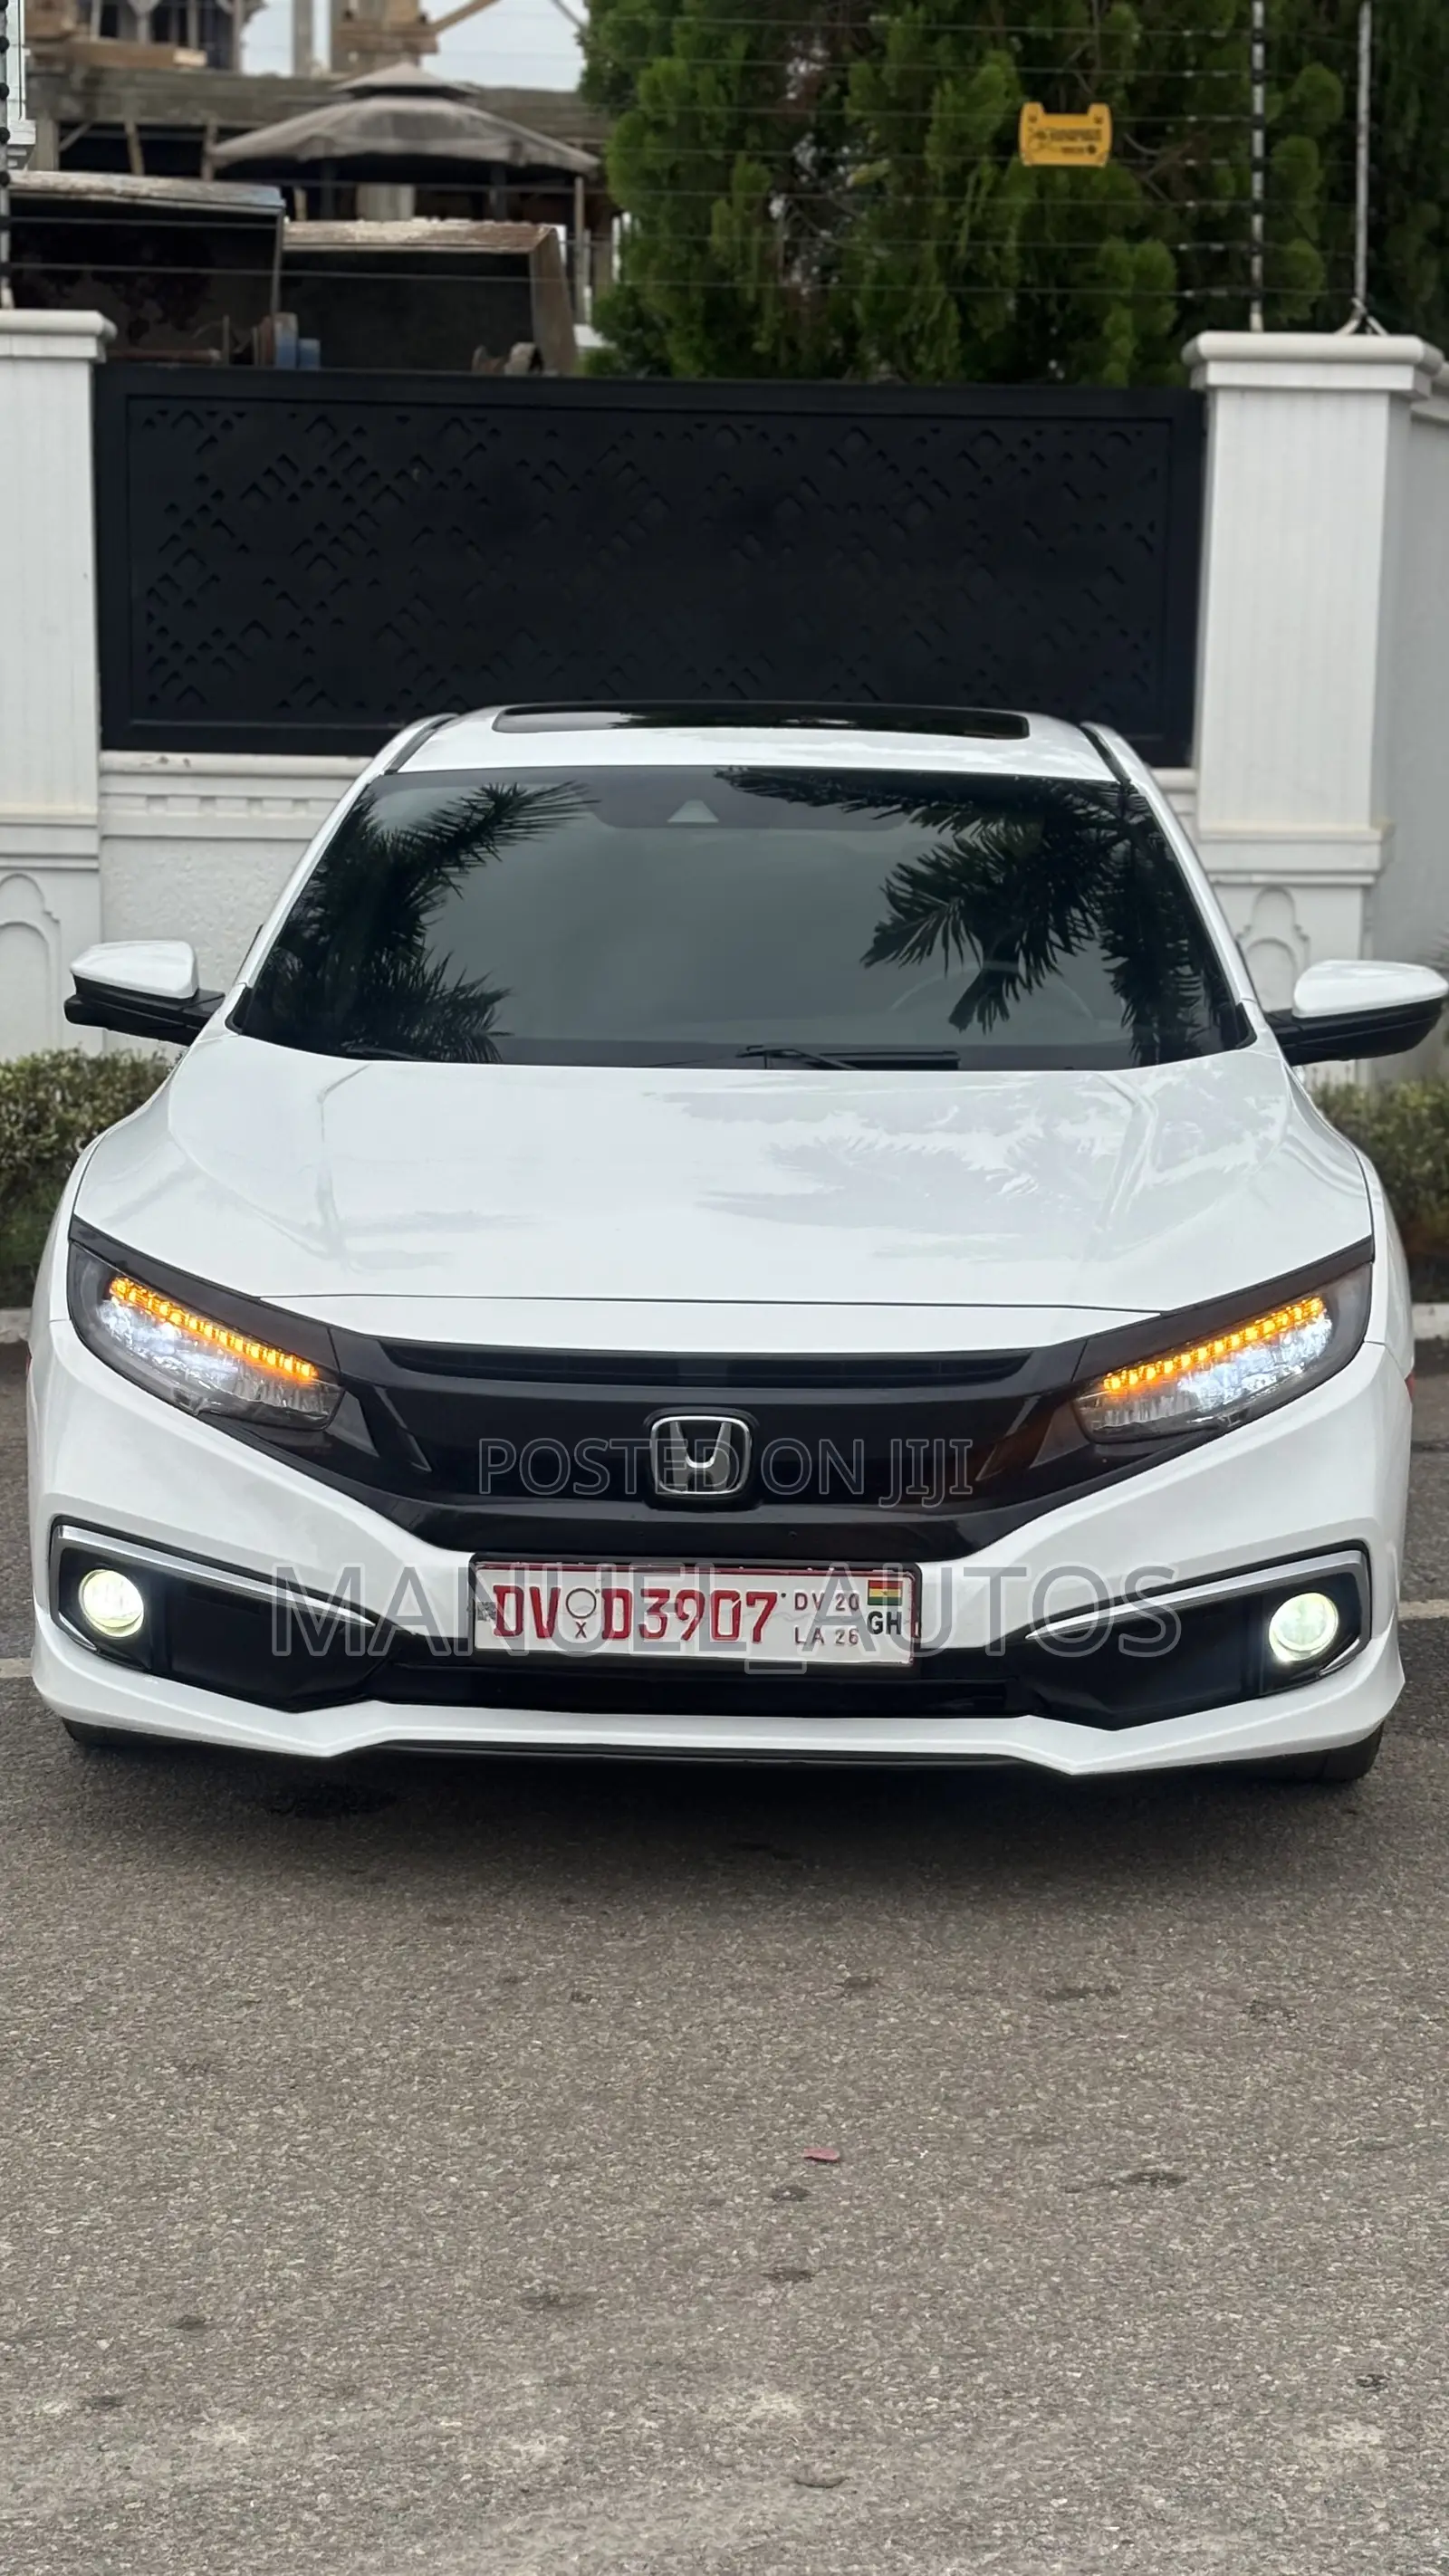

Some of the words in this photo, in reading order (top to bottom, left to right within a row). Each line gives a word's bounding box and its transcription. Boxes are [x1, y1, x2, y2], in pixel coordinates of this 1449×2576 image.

[794, 1592, 825, 1612] DV
[835, 1593, 860, 1612] 20
[493, 1585, 561, 1639] DV
[601, 1587, 778, 1643] D3907
[867, 1611, 902, 1636] GH
[794, 1626, 825, 1645] LA
[835, 1627, 859, 1645] 26
